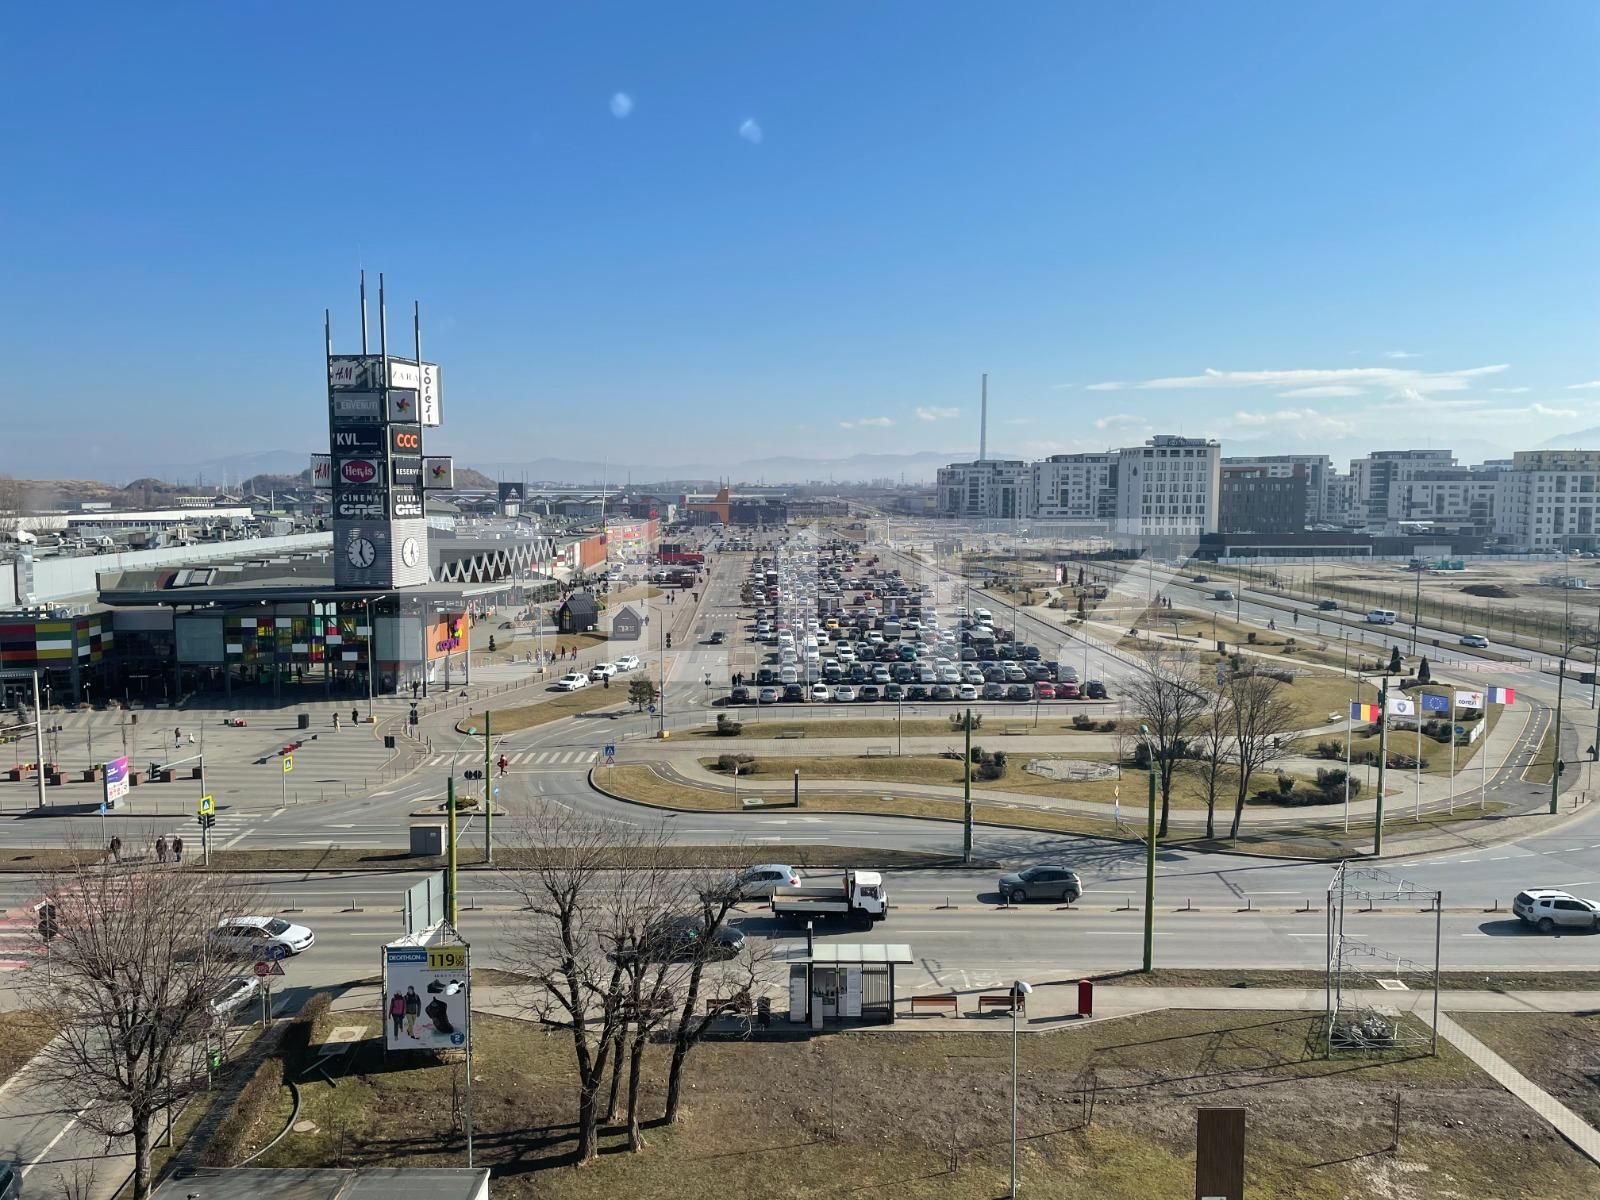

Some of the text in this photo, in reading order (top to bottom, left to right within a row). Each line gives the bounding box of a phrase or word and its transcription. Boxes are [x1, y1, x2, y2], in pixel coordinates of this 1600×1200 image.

[396, 433, 418, 448] CCC
[344, 465, 373, 477] Hervis
[341, 494, 380, 502] CINEMA
[430, 953, 454, 967] 119
